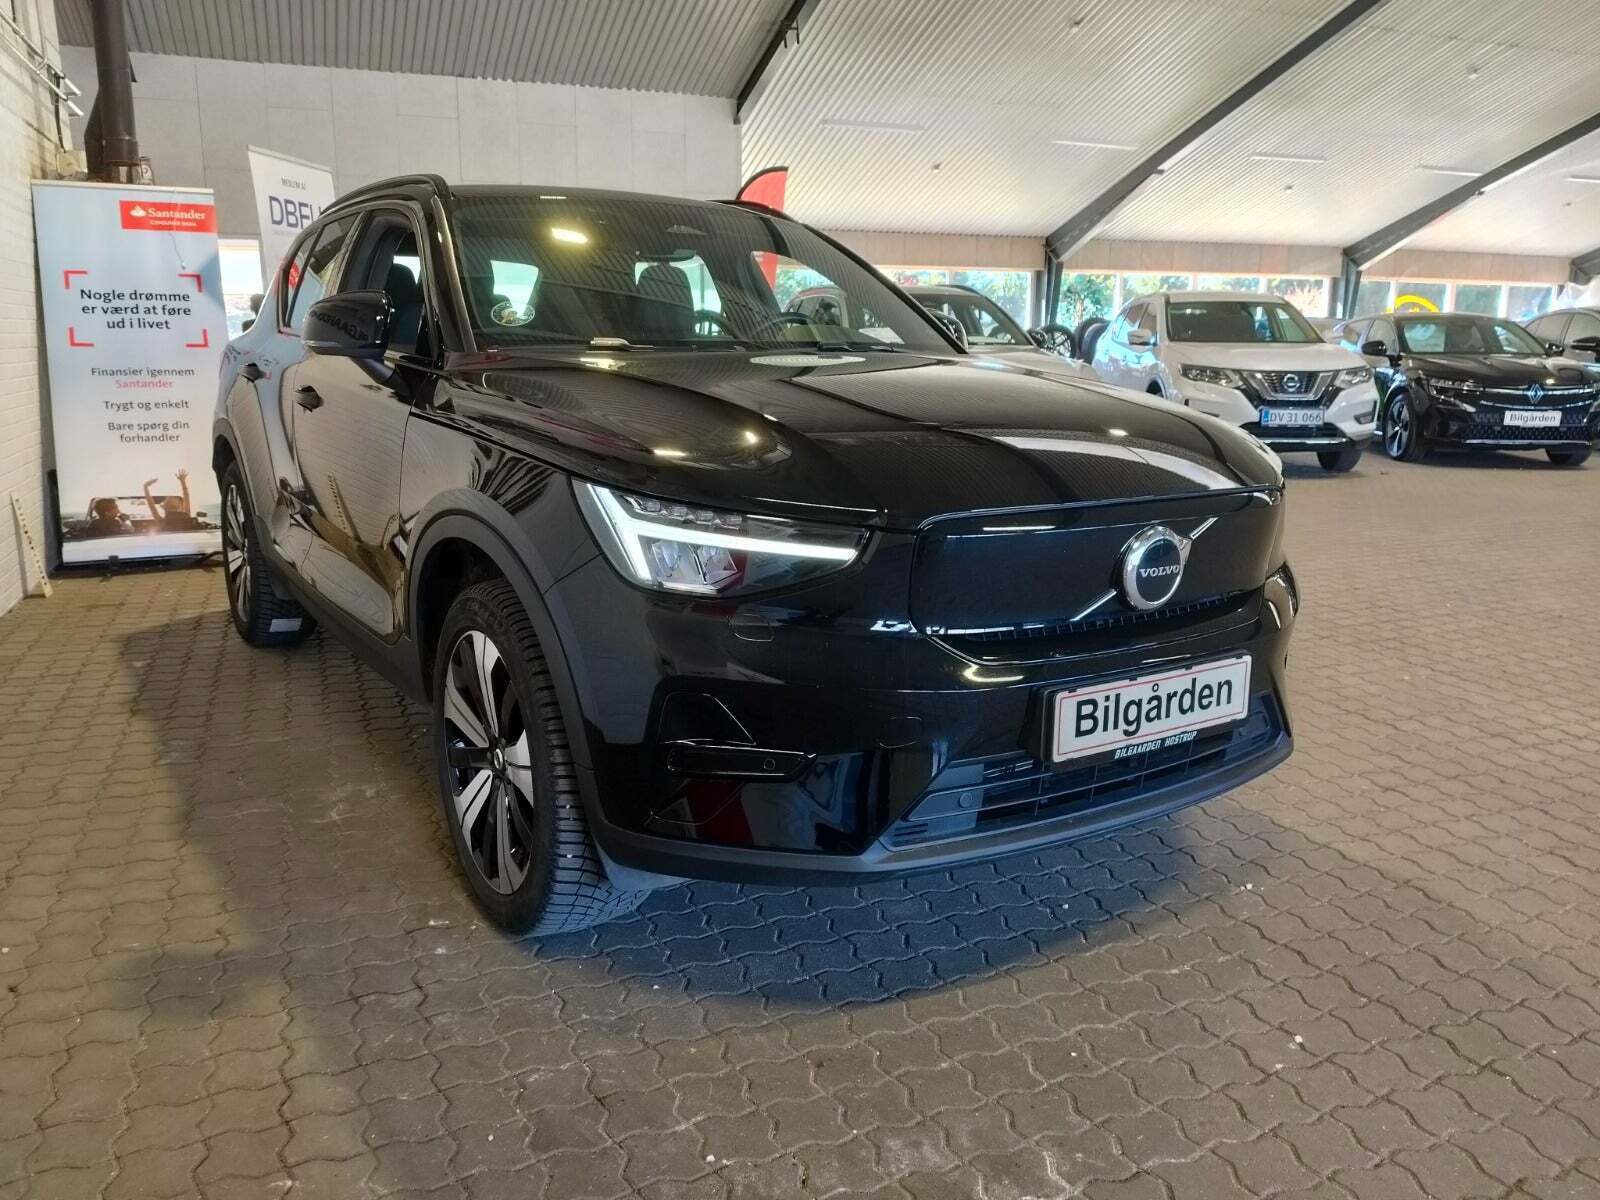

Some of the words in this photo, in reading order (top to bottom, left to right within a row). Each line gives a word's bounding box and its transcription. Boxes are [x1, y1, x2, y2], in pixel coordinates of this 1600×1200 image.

[147, 207, 206, 220] Santander
[80, 289, 125, 303] Nogle
[129, 289, 190, 302] drømme
[81, 305, 97, 315] er
[101, 303, 140, 315] værd
[143, 304, 159, 316] at
[162, 304, 191, 316] føre
[106, 318, 125, 329] ud
[137, 318, 171, 330] livet
[91, 367, 143, 377] Finansier
[146, 367, 195, 378] igennem
[115, 379, 173, 389] Santander
[104, 400, 134, 412] Trygt
[137, 402, 152, 411] og
[154, 400, 190, 409] enkelt
[1287, 413, 1298, 421] 31
[108, 422, 134, 431] Bare
[137, 422, 169, 432] spørg
[171, 421, 190, 430] din
[120, 433, 180, 443] forhandler
[1139, 564, 1180, 578] VOLVO
[1074, 676, 1233, 738] Bilgården
[1114, 742, 1161, 760] BILGAARDEN
[1164, 730, 1198, 746] HOSTRUP
